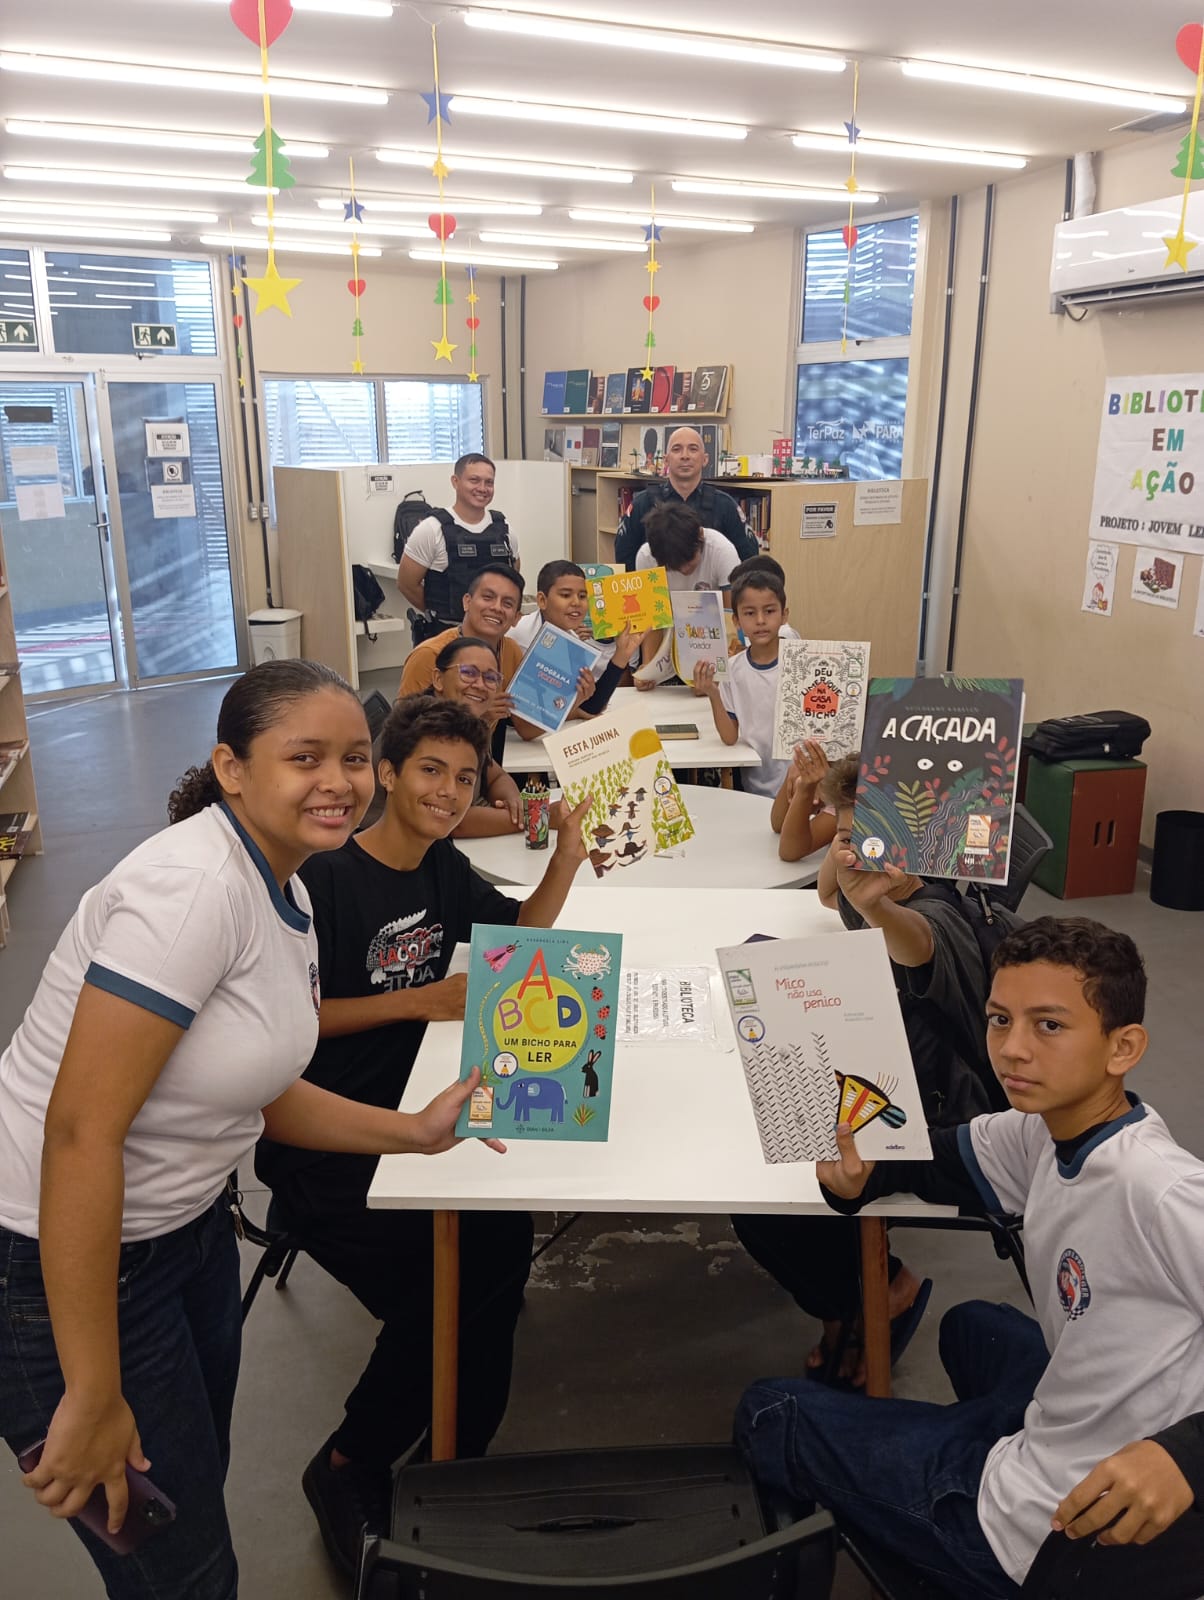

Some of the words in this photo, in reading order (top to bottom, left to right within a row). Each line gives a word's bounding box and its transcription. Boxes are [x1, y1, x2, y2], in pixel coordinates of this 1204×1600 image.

[807, 425, 845, 440] TerPaz
[1152, 428, 1184, 451] EM
[1130, 461, 1195, 501] AÇÃO
[1100, 516, 1139, 531] PROJETO
[1148, 520, 1183, 536] JOVEM
[611, 580, 619, 593] O
[620, 576, 643, 592] SACO
[536, 662, 571, 685] PROGRAMA
[815, 667, 832, 677] DEU
[805, 708, 837, 719] BICHO
[882, 717, 897, 739] A
[900, 715, 996, 745] CAÇADA
[563, 740, 590, 758] FESTA
[589, 728, 620, 750] JUNINA
[775, 978, 806, 991] Mico
[680, 981, 695, 1024] BIBLIOTECA
[787, 990, 805, 999] não
[803, 996, 842, 1013] penico
[504, 1038, 519, 1046] UM
[521, 1039, 551, 1047] BICHO
[553, 1040, 577, 1048] PARA
[527, 1051, 552, 1063] LER
